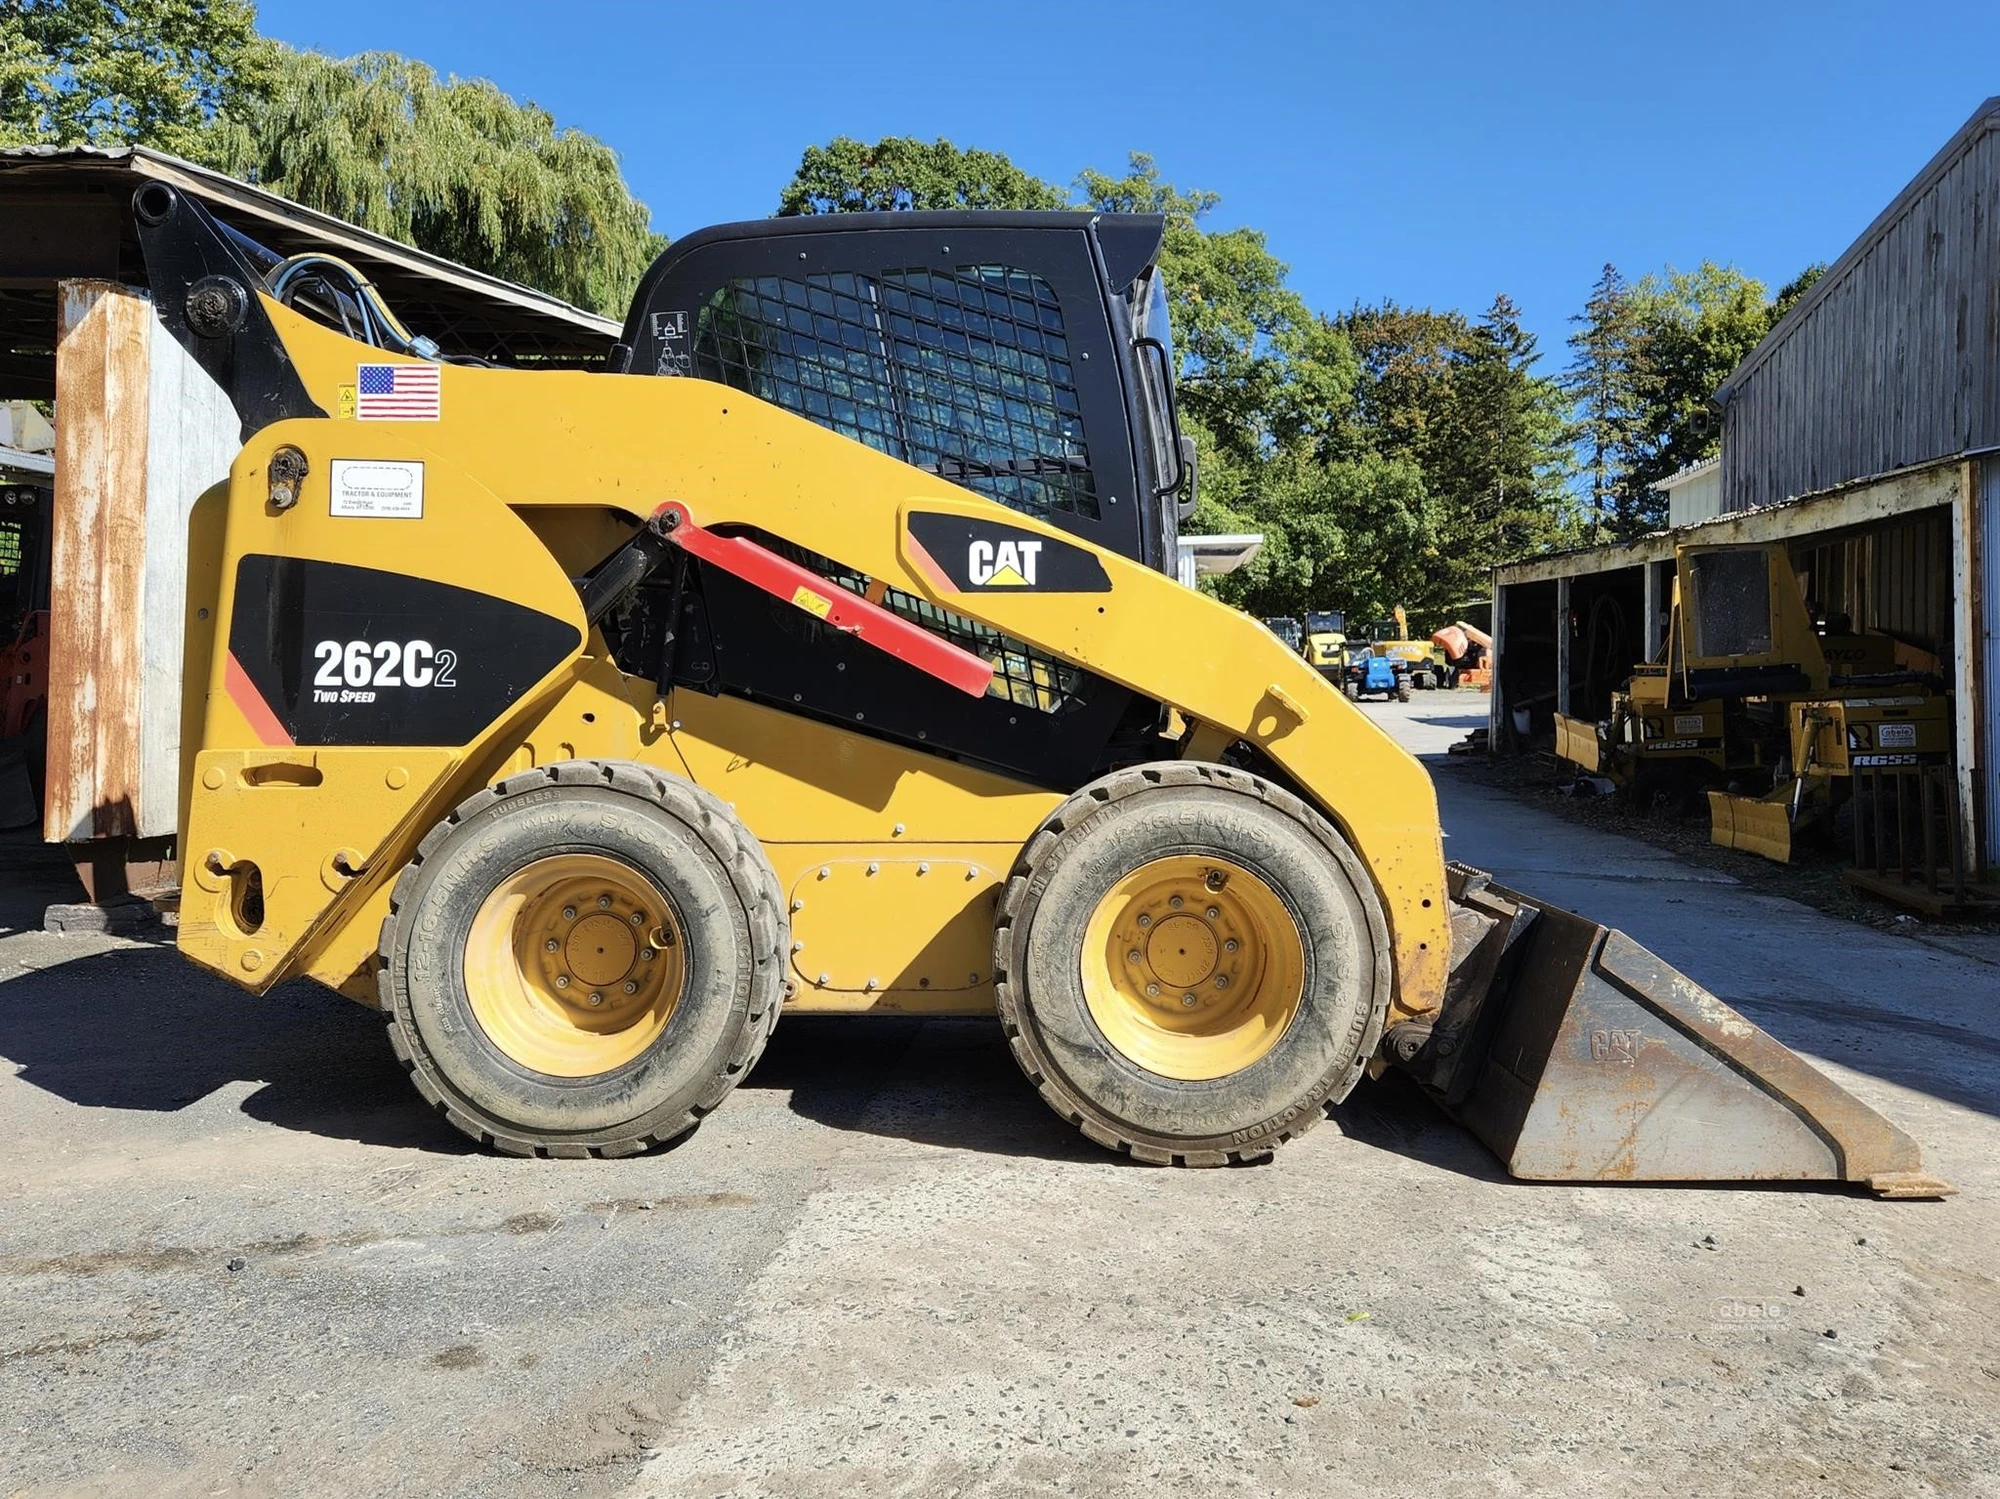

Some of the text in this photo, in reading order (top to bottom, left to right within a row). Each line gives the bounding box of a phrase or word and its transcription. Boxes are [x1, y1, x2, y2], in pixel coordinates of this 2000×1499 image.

[341, 490, 370, 498] TRACTOR
[377, 491, 412, 499] EQUIPMENT
[969, 540, 1042, 586] CAT
[1824, 648, 1866, 661] AYCO
[489, 790, 562, 819] TUBELESS
[521, 813, 567, 831] NYLON
[600, 811, 678, 859] SKS-3
[1044, 801, 1125, 874] STABILITY
[1281, 815, 1338, 872] TUBELESS
[682, 831, 751, 1014] SUPER TRACTION
[394, 944, 421, 1048] STABILITY
[1590, 1029, 1641, 1061] CAT
[1231, 1001, 1369, 1146] SUPER TRACTION
